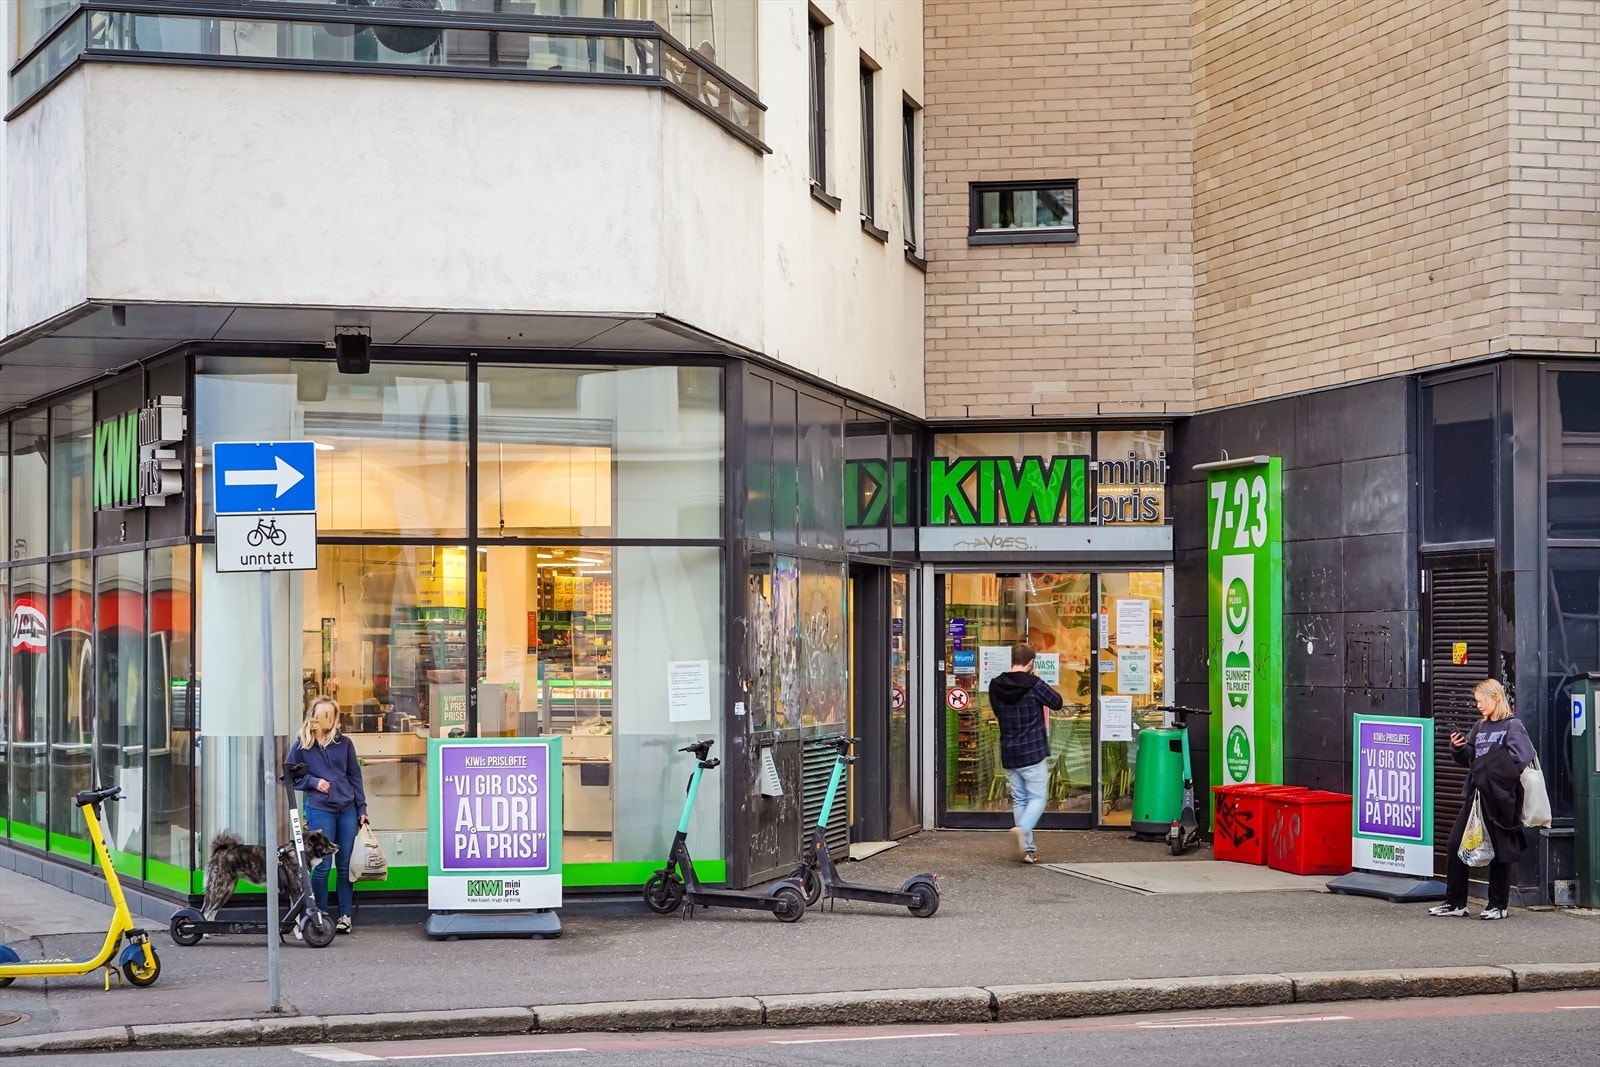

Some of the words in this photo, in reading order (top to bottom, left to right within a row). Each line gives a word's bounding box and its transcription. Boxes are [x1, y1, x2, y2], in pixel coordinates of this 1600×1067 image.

[93, 408, 140, 512] KIWI
[1097, 450, 1167, 485] mini
[928, 455, 1090, 527] KIWI
[1097, 488, 1159, 525] pris
[1210, 475, 1269, 550] 7-23
[239, 551, 294, 566] unntatt
[1052, 594, 1108, 605] SUNNHT
[1228, 597, 1242, 605] PLUSS
[1033, 660, 1056, 670] DVASK
[1225, 670, 1251, 681] SUNNHET
[450, 701, 466, 711] PRES
[1573, 700, 1583, 729] P
[1373, 732, 1386, 742] KIWIs
[1386, 732, 1410, 744] PRISLØFTE
[465, 756, 486, 766] KIWIs
[487, 755, 527, 767] PRISLØFTE
[1379, 750, 1395, 768] GIR
[1397, 752, 1416, 770] OSS
[475, 774, 503, 796] GIR
[506, 773, 538, 795] OSS
[1366, 768, 1416, 804] ALDRI
[455, 796, 537, 832] ALDRI
[1365, 797, 1382, 825] PÅ
[292, 817, 303, 845] BIRD
[455, 827, 481, 859] PÅ
[1373, 843, 1395, 860] KIWI
[1395, 846, 1405, 854] mini
[1395, 853, 1405, 862] pris
[467, 880, 503, 897] KIWI
[504, 880, 521, 888] mini
[504, 888, 520, 897] pris
